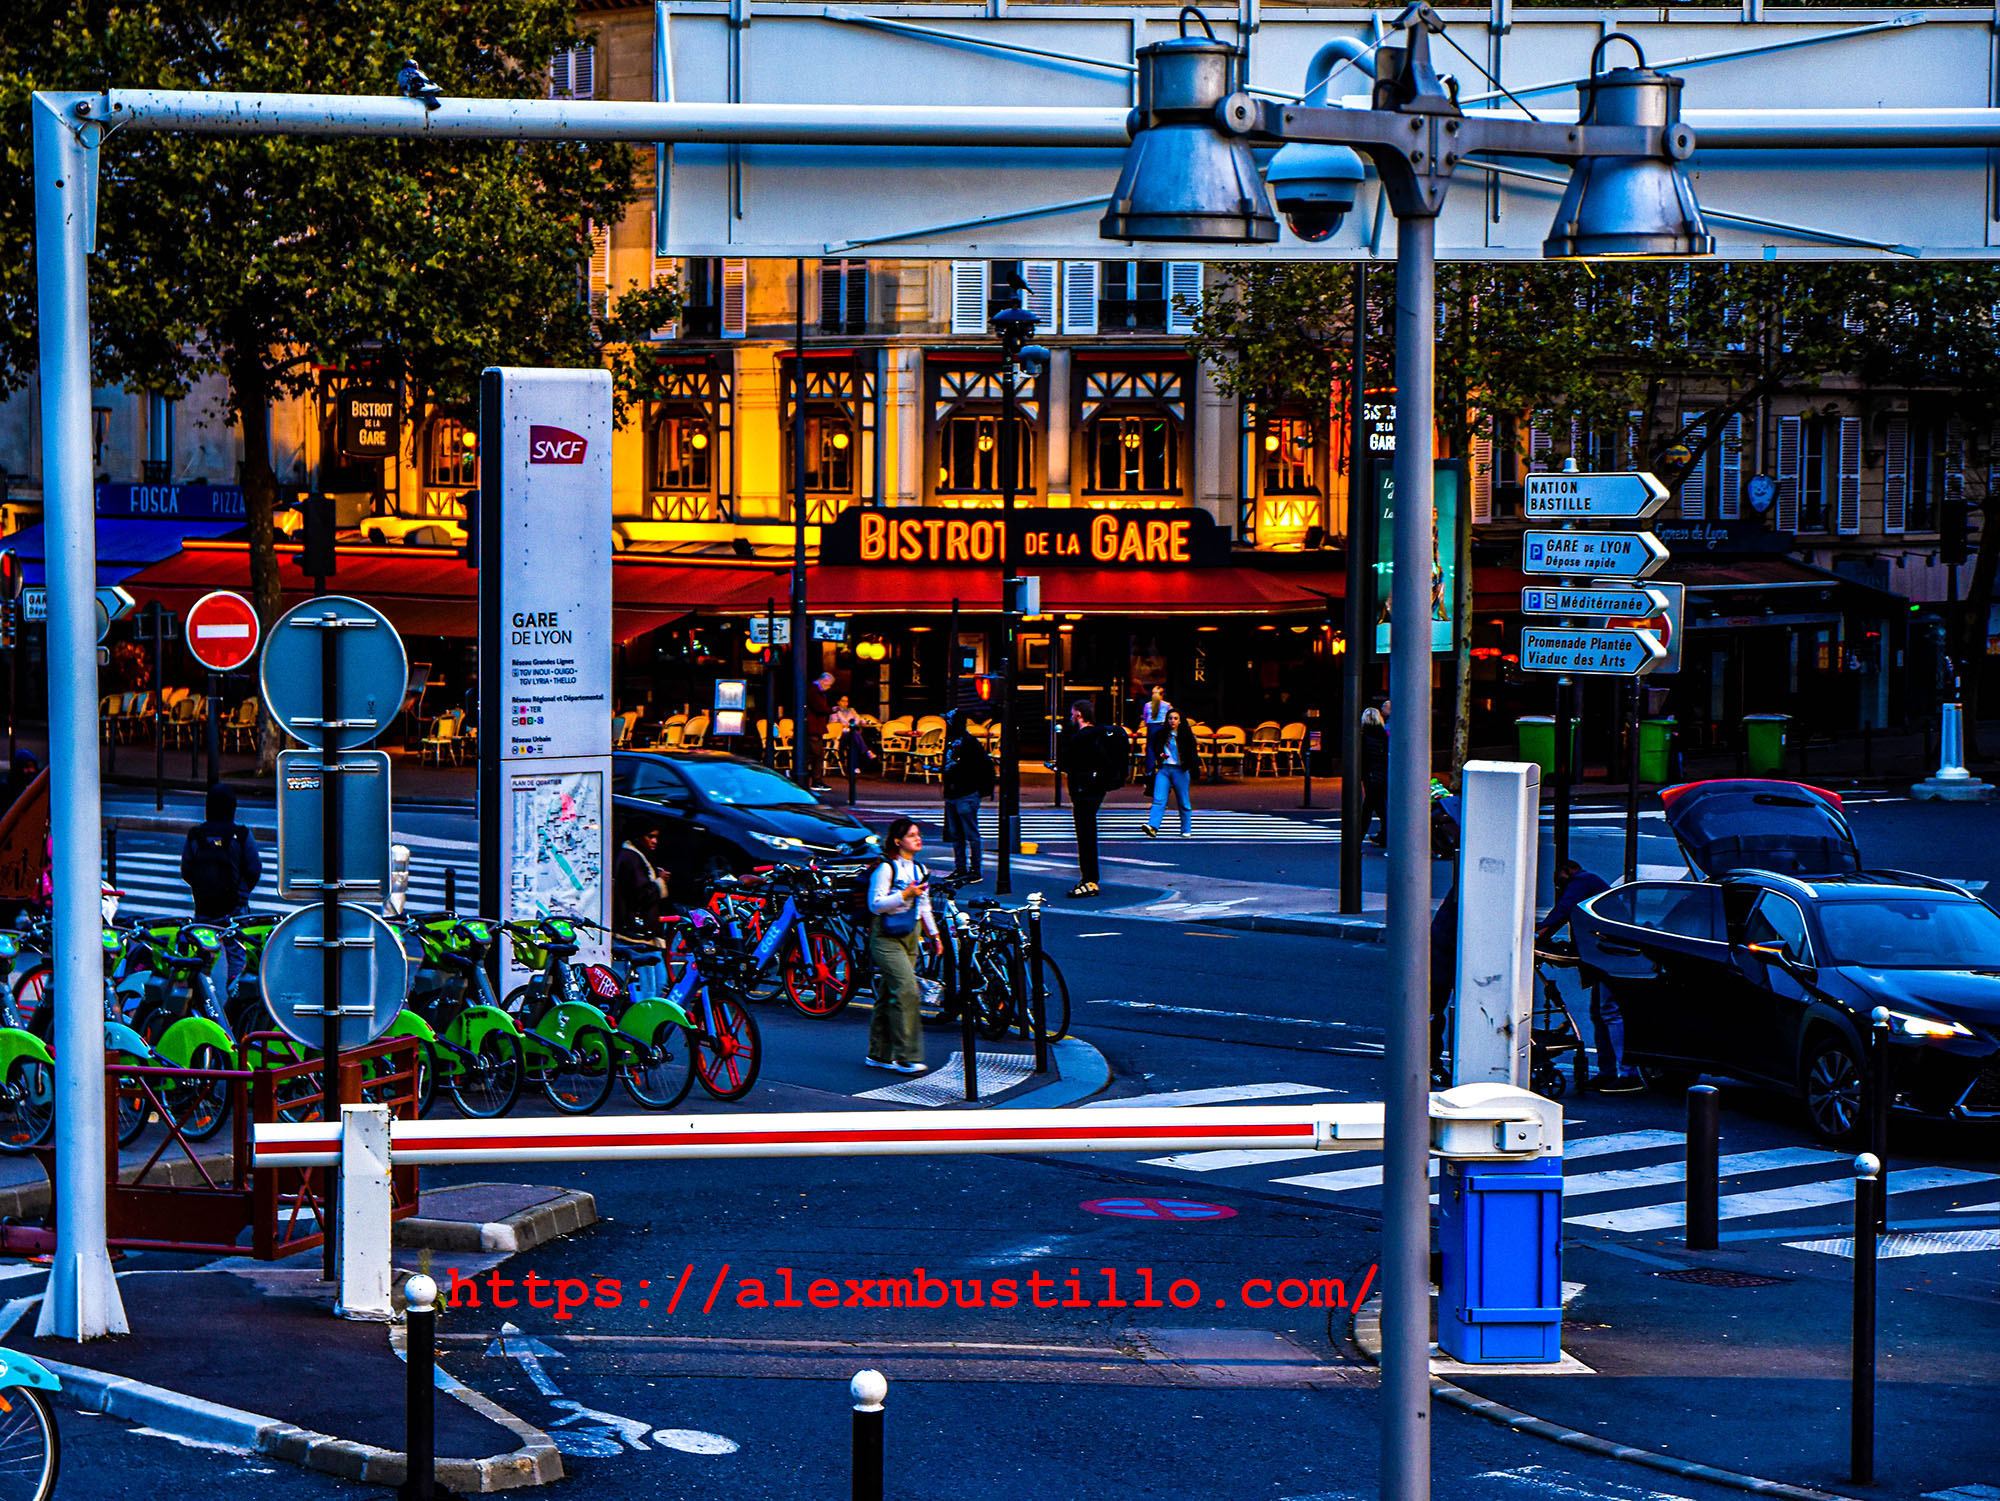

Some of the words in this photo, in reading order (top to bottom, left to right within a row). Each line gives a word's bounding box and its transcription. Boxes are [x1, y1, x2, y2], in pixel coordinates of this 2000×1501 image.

[351, 400, 394, 418] BISTROT
[359, 428, 387, 446] GARE
[532, 440, 584, 460] SNCF
[1531, 481, 1578, 494] NATION
[1530, 497, 1592, 511] BASTILLE
[1025, 531, 1050, 556] DE
[1056, 532, 1081, 556] LA
[1090, 513, 1192, 563] GARE
[1546, 539, 1579, 553] GARE
[1583, 544, 1595, 553] DE
[1600, 540, 1632, 554] LYON
[1545, 555, 1581, 569] Dépose
[1584, 557, 1616, 570] rapide
[28, 594, 48, 605] GAR
[512, 612, 558, 628] GARE
[512, 631, 531, 645] DE
[534, 630, 572, 645] LYON
[1528, 634, 1587, 649] Promenade
[1589, 637, 1633, 651] Plantée
[556, 658, 575, 667] Lignes
[1529, 651, 1568, 664] Viaduc
[1573, 653, 1594, 666] des
[1600, 654, 1626, 668] Arts
